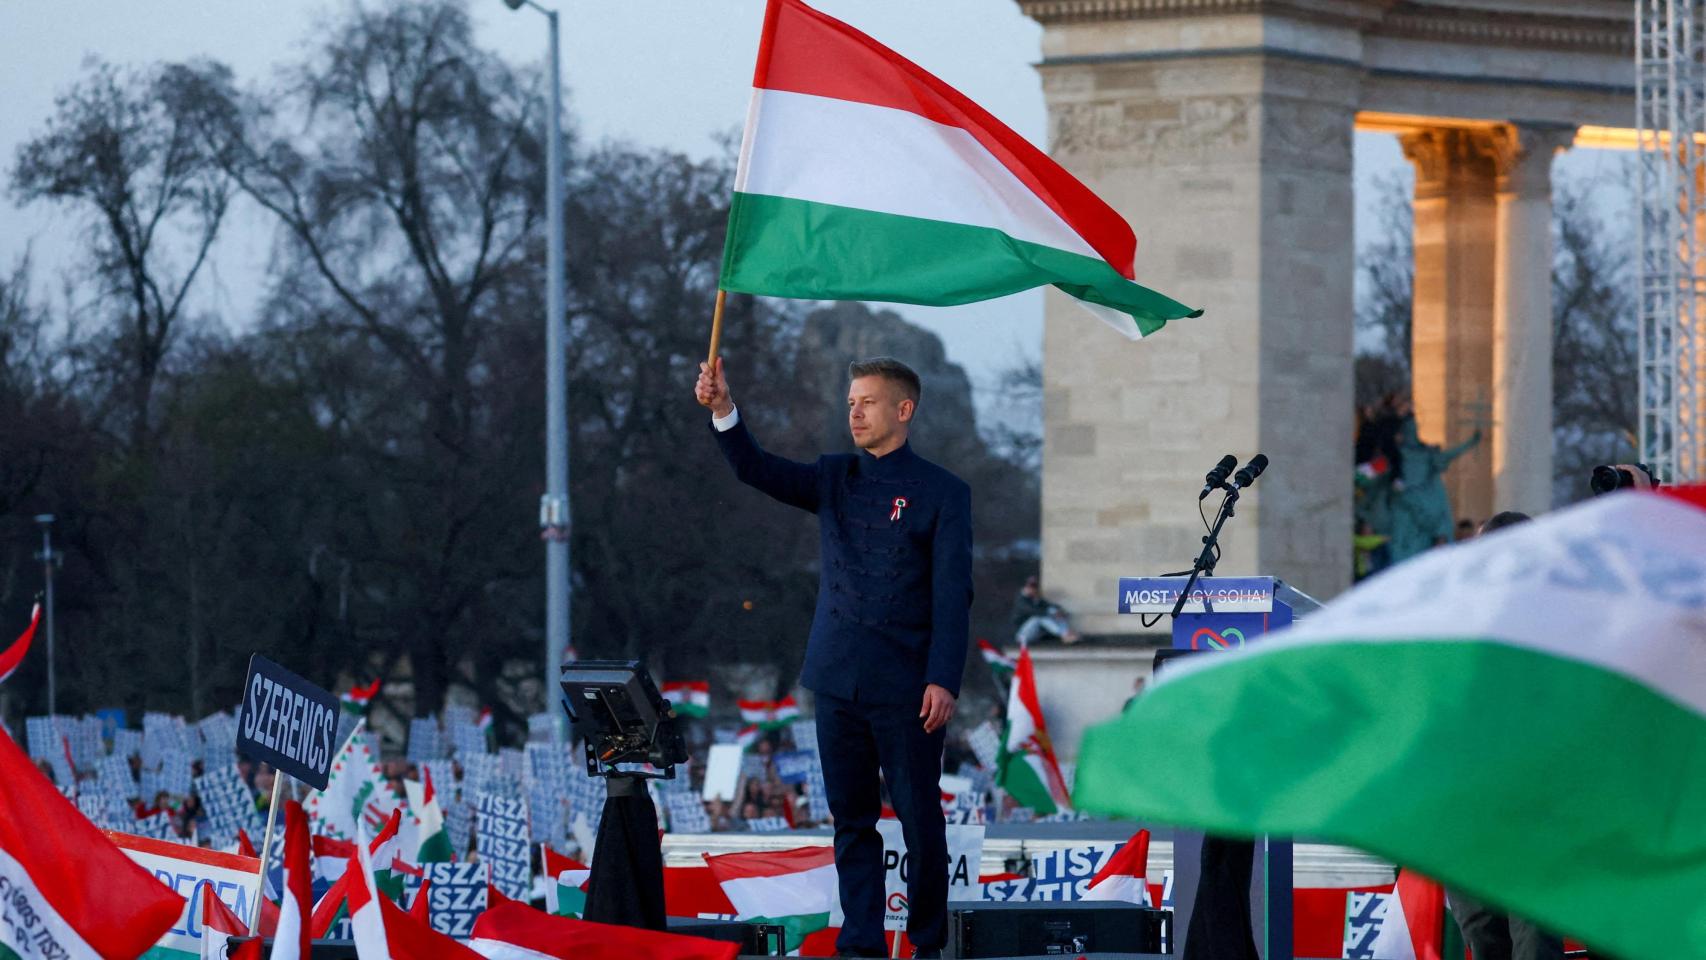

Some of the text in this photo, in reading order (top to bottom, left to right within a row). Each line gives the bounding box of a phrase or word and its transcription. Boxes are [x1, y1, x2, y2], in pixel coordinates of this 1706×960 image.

[1125, 590, 1169, 604] MOST
[1218, 589, 1266, 604] SOHA!
[244, 672, 334, 775] SZERENCS
[476, 791, 528, 820] TISZA
[477, 812, 528, 841] TISZA
[477, 833, 529, 862] TISZA
